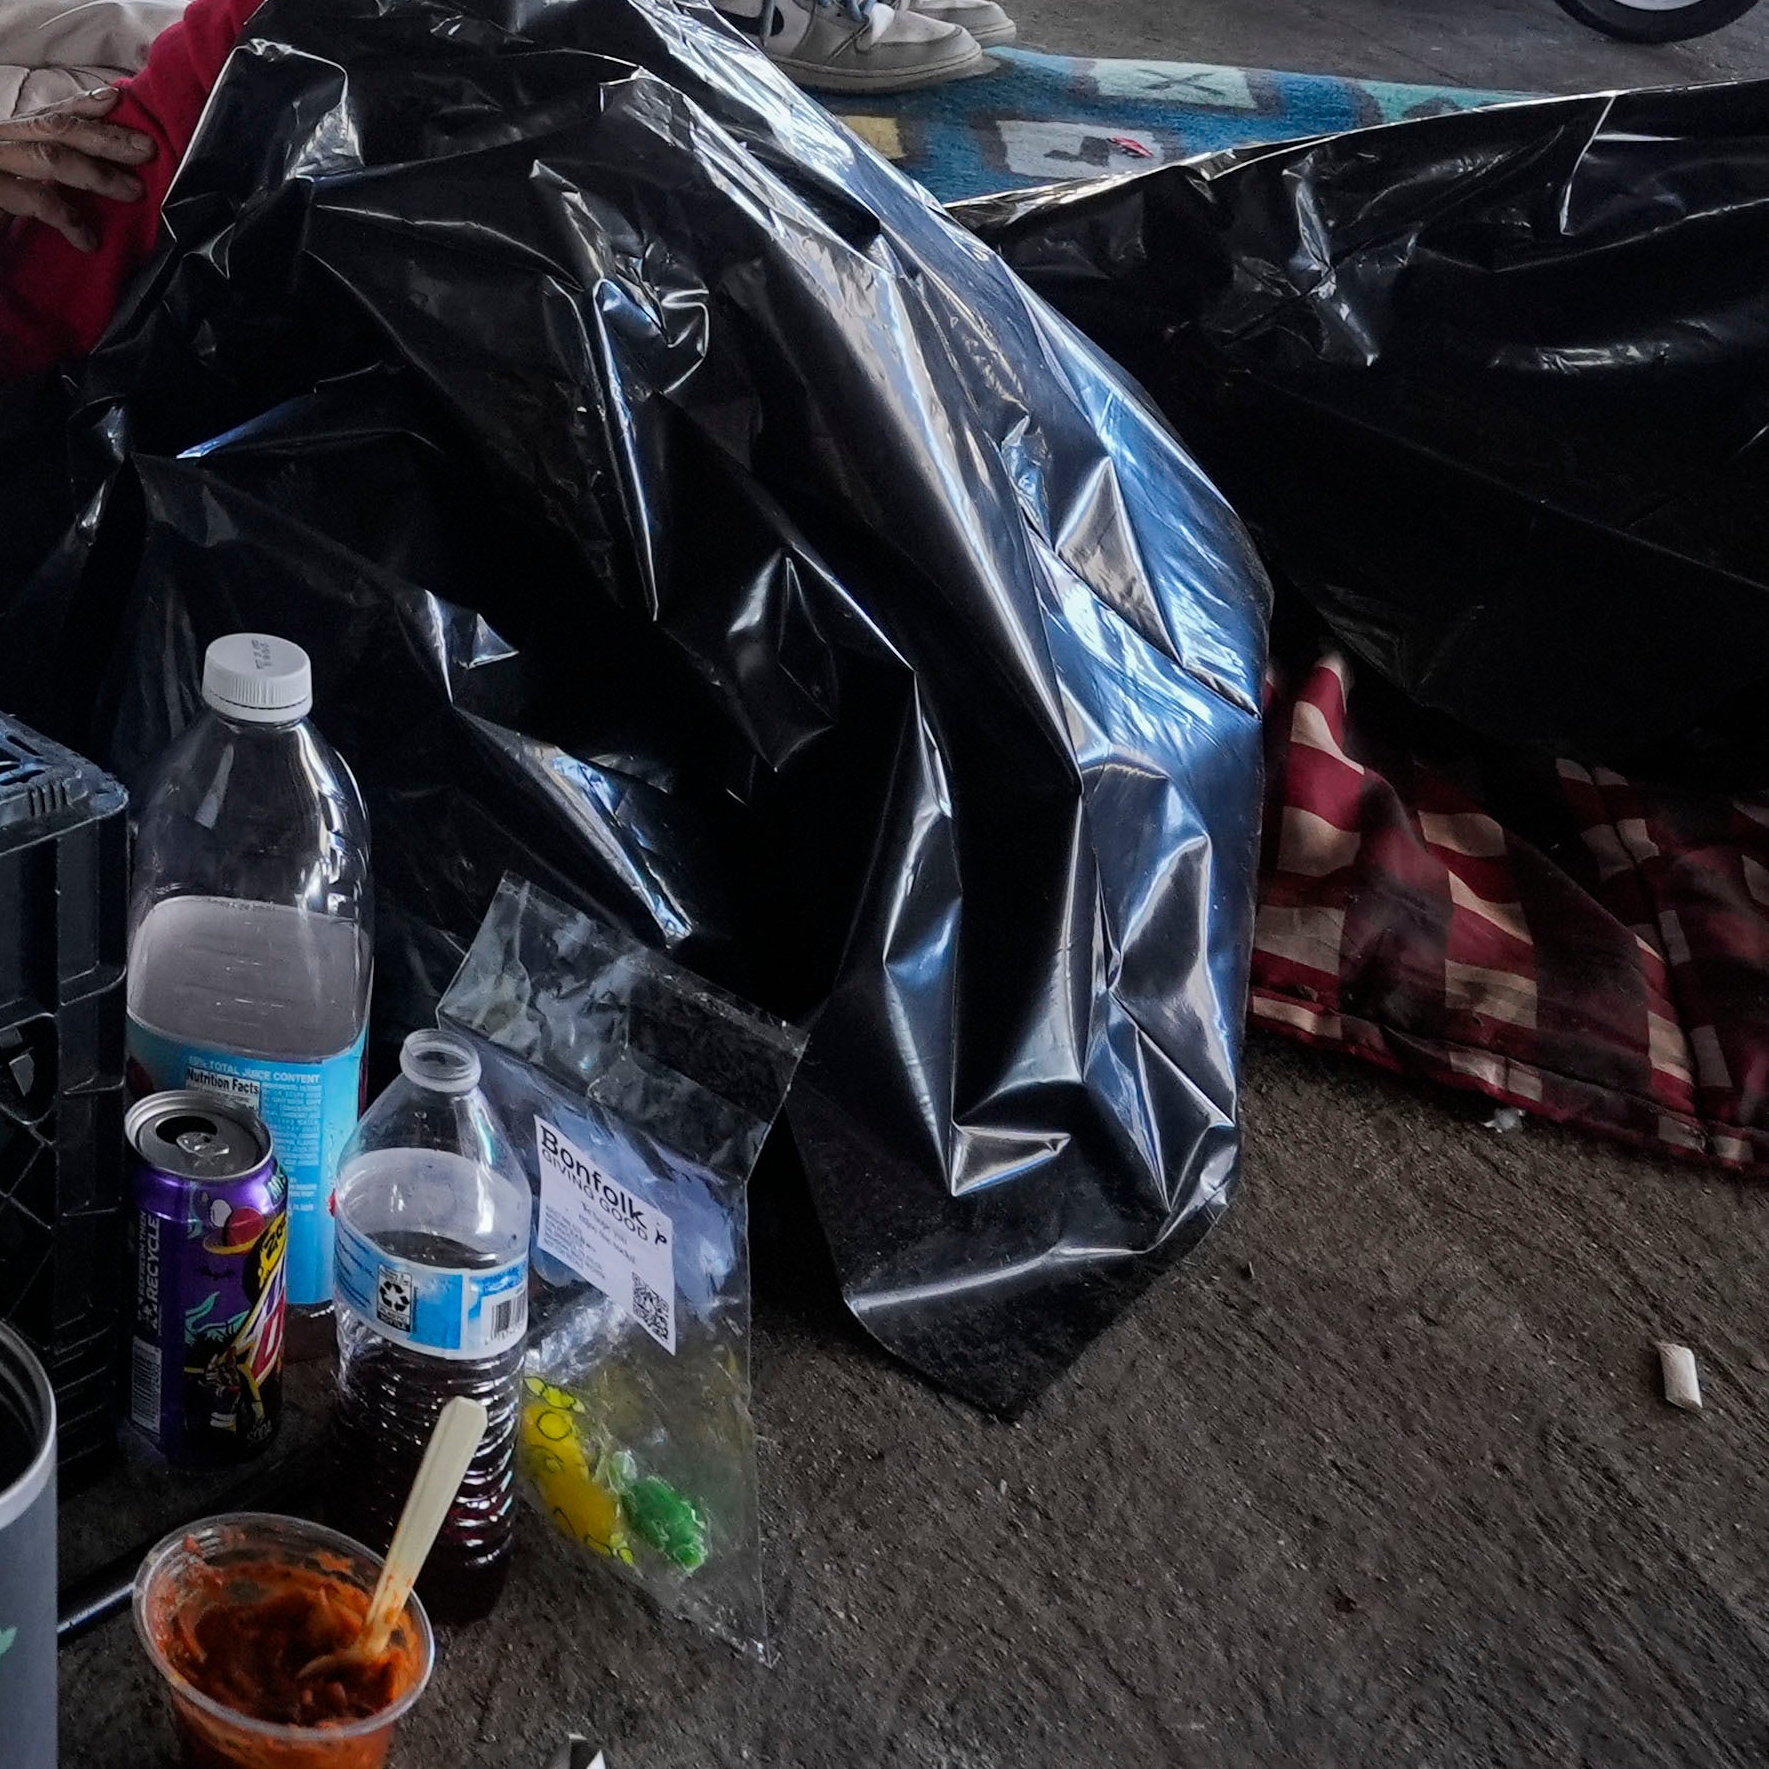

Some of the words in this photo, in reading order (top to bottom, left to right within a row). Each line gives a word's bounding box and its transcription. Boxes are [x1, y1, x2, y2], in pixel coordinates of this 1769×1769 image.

[186, 1068, 230, 1091] Nutrition
[231, 1078, 260, 1096] Facts
[210, 1060, 240, 1077] TOTAL
[241, 1068, 271, 1081] JUICE
[272, 1071, 321, 1084] CONTENT
[540, 1124, 648, 1230] Bonfolk
[541, 1148, 595, 1201] GIVING
[599, 1199, 648, 1242] GOOD
[146, 1214, 160, 1305] RECYCLE
